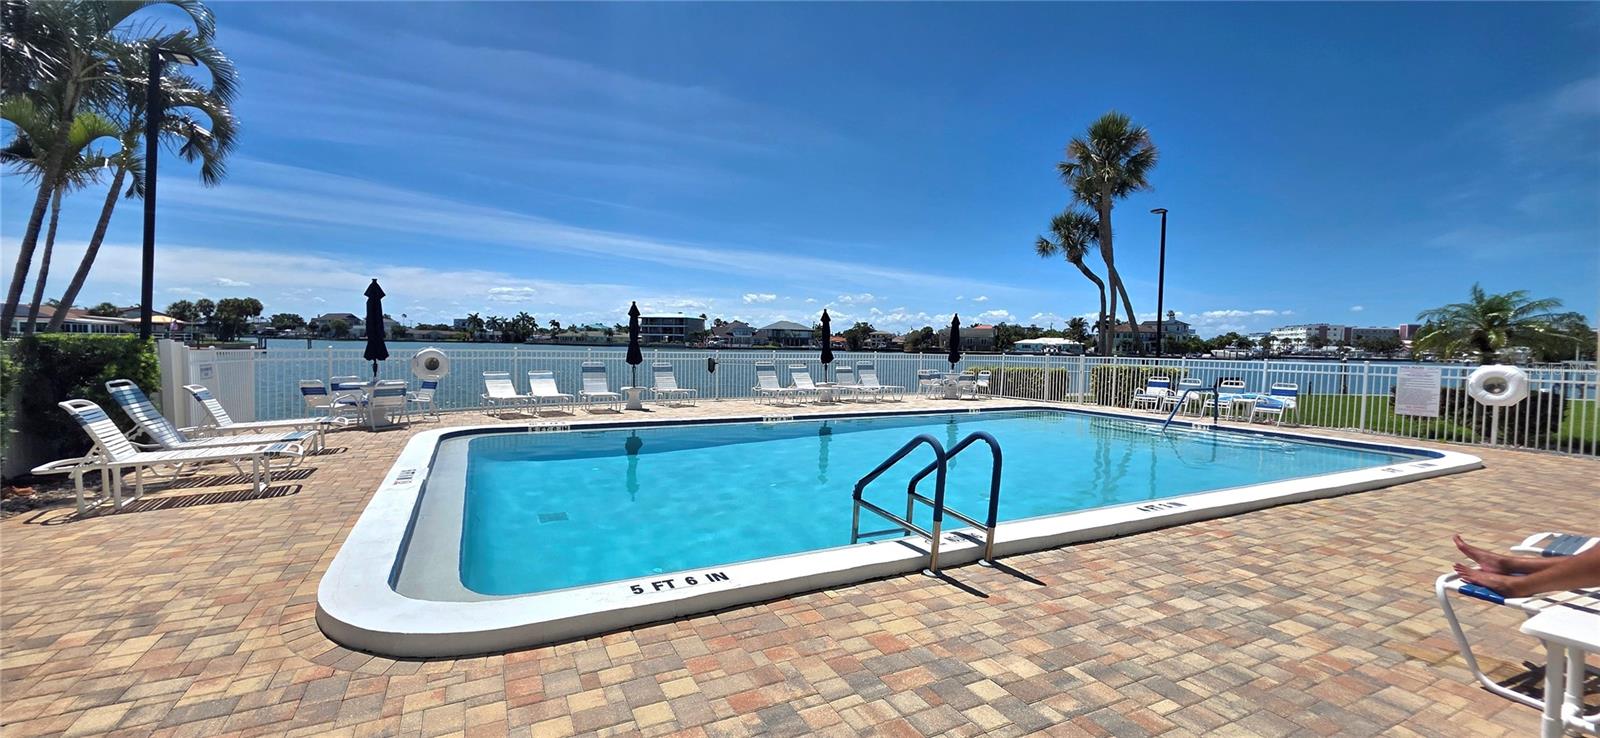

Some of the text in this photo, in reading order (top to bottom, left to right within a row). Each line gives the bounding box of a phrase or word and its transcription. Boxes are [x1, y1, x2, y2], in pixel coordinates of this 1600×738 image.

[630, 572, 730, 595] 5 FT 6 IN
